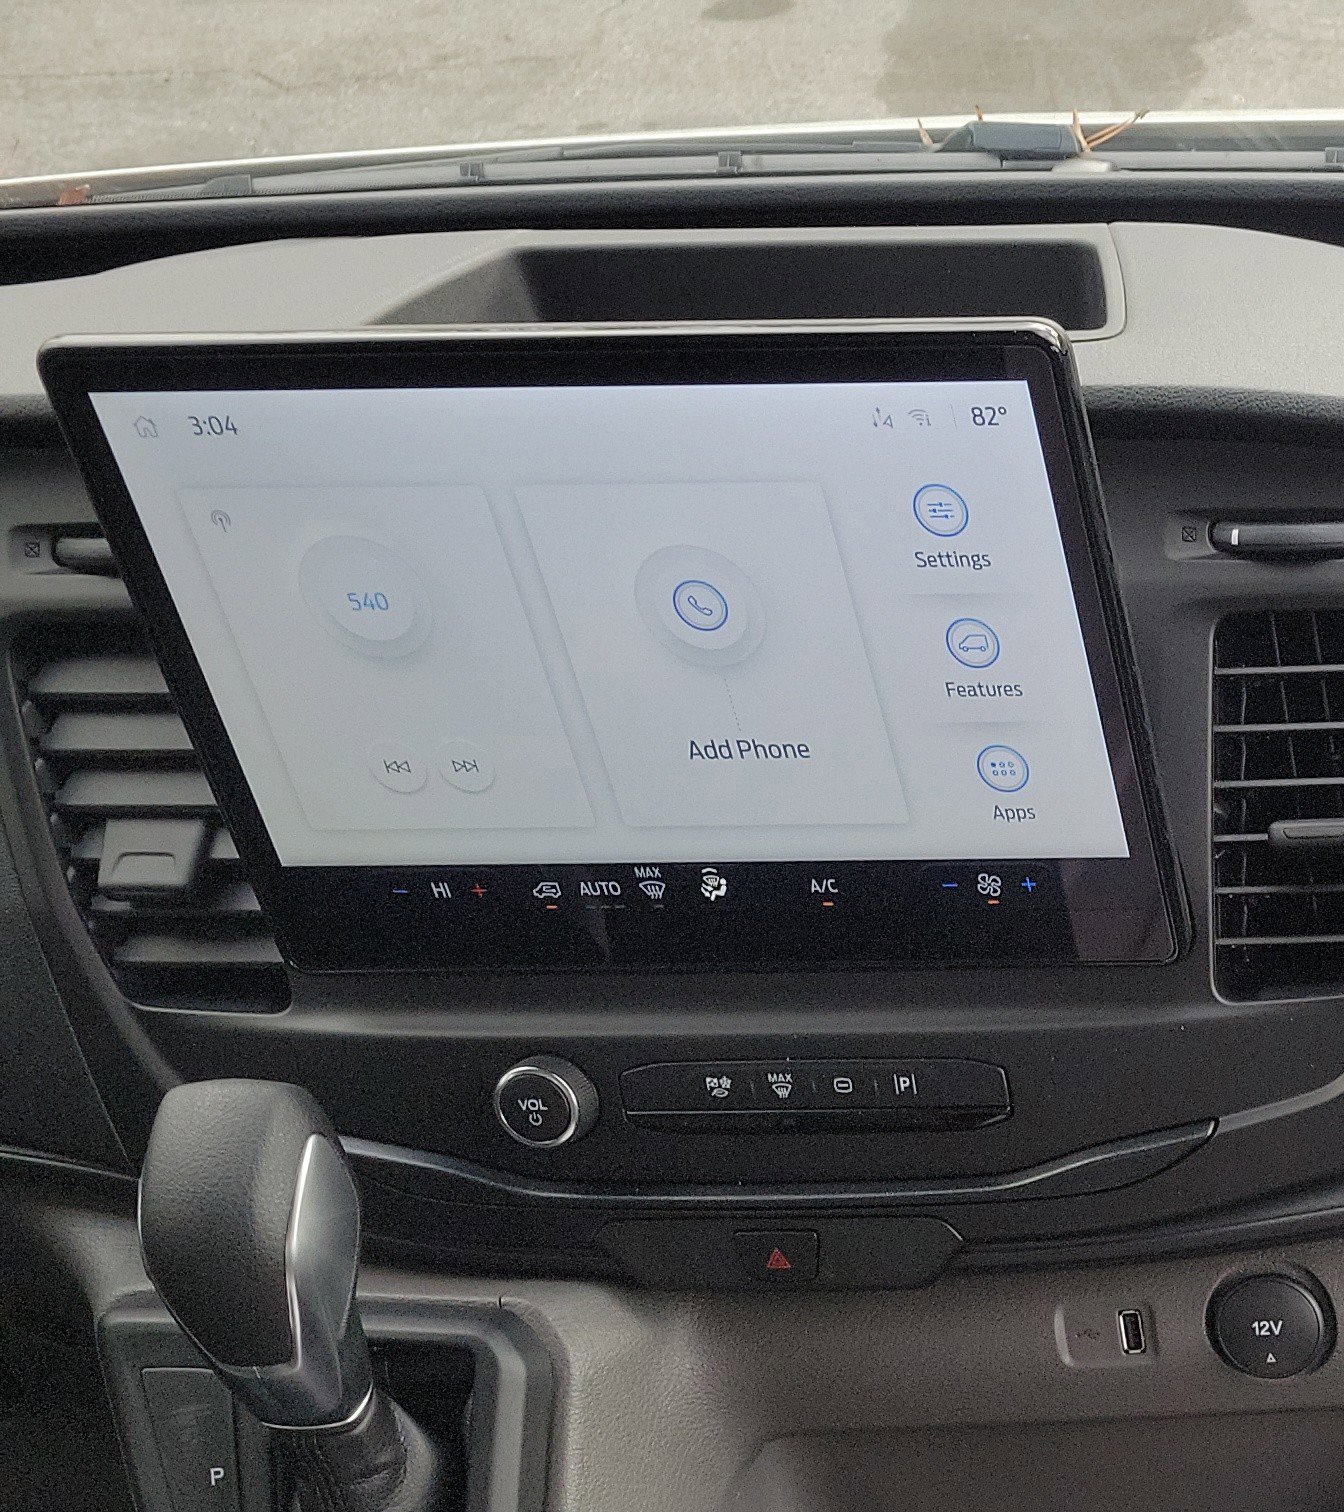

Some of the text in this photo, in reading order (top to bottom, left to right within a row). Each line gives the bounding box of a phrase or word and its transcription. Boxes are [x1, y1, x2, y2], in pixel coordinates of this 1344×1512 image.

[970, 406, 1007, 427] 82°
[187, 415, 238, 437] 3:04
[914, 550, 992, 571] Settings
[346, 592, 390, 612] 540
[944, 681, 1024, 698] Features
[689, 738, 811, 760] Add Phone
[993, 804, 1036, 823] Apps
[634, 866, 662, 879] MAX
[430, 882, 452, 898] HI
[580, 881, 622, 896] AUTO
[810, 878, 839, 894] A/C
[767, 1072, 793, 1085] MAX
[517, 1098, 548, 1111] VOL
[1252, 1320, 1283, 1336] 12V
[209, 1467, 225, 1486] P
